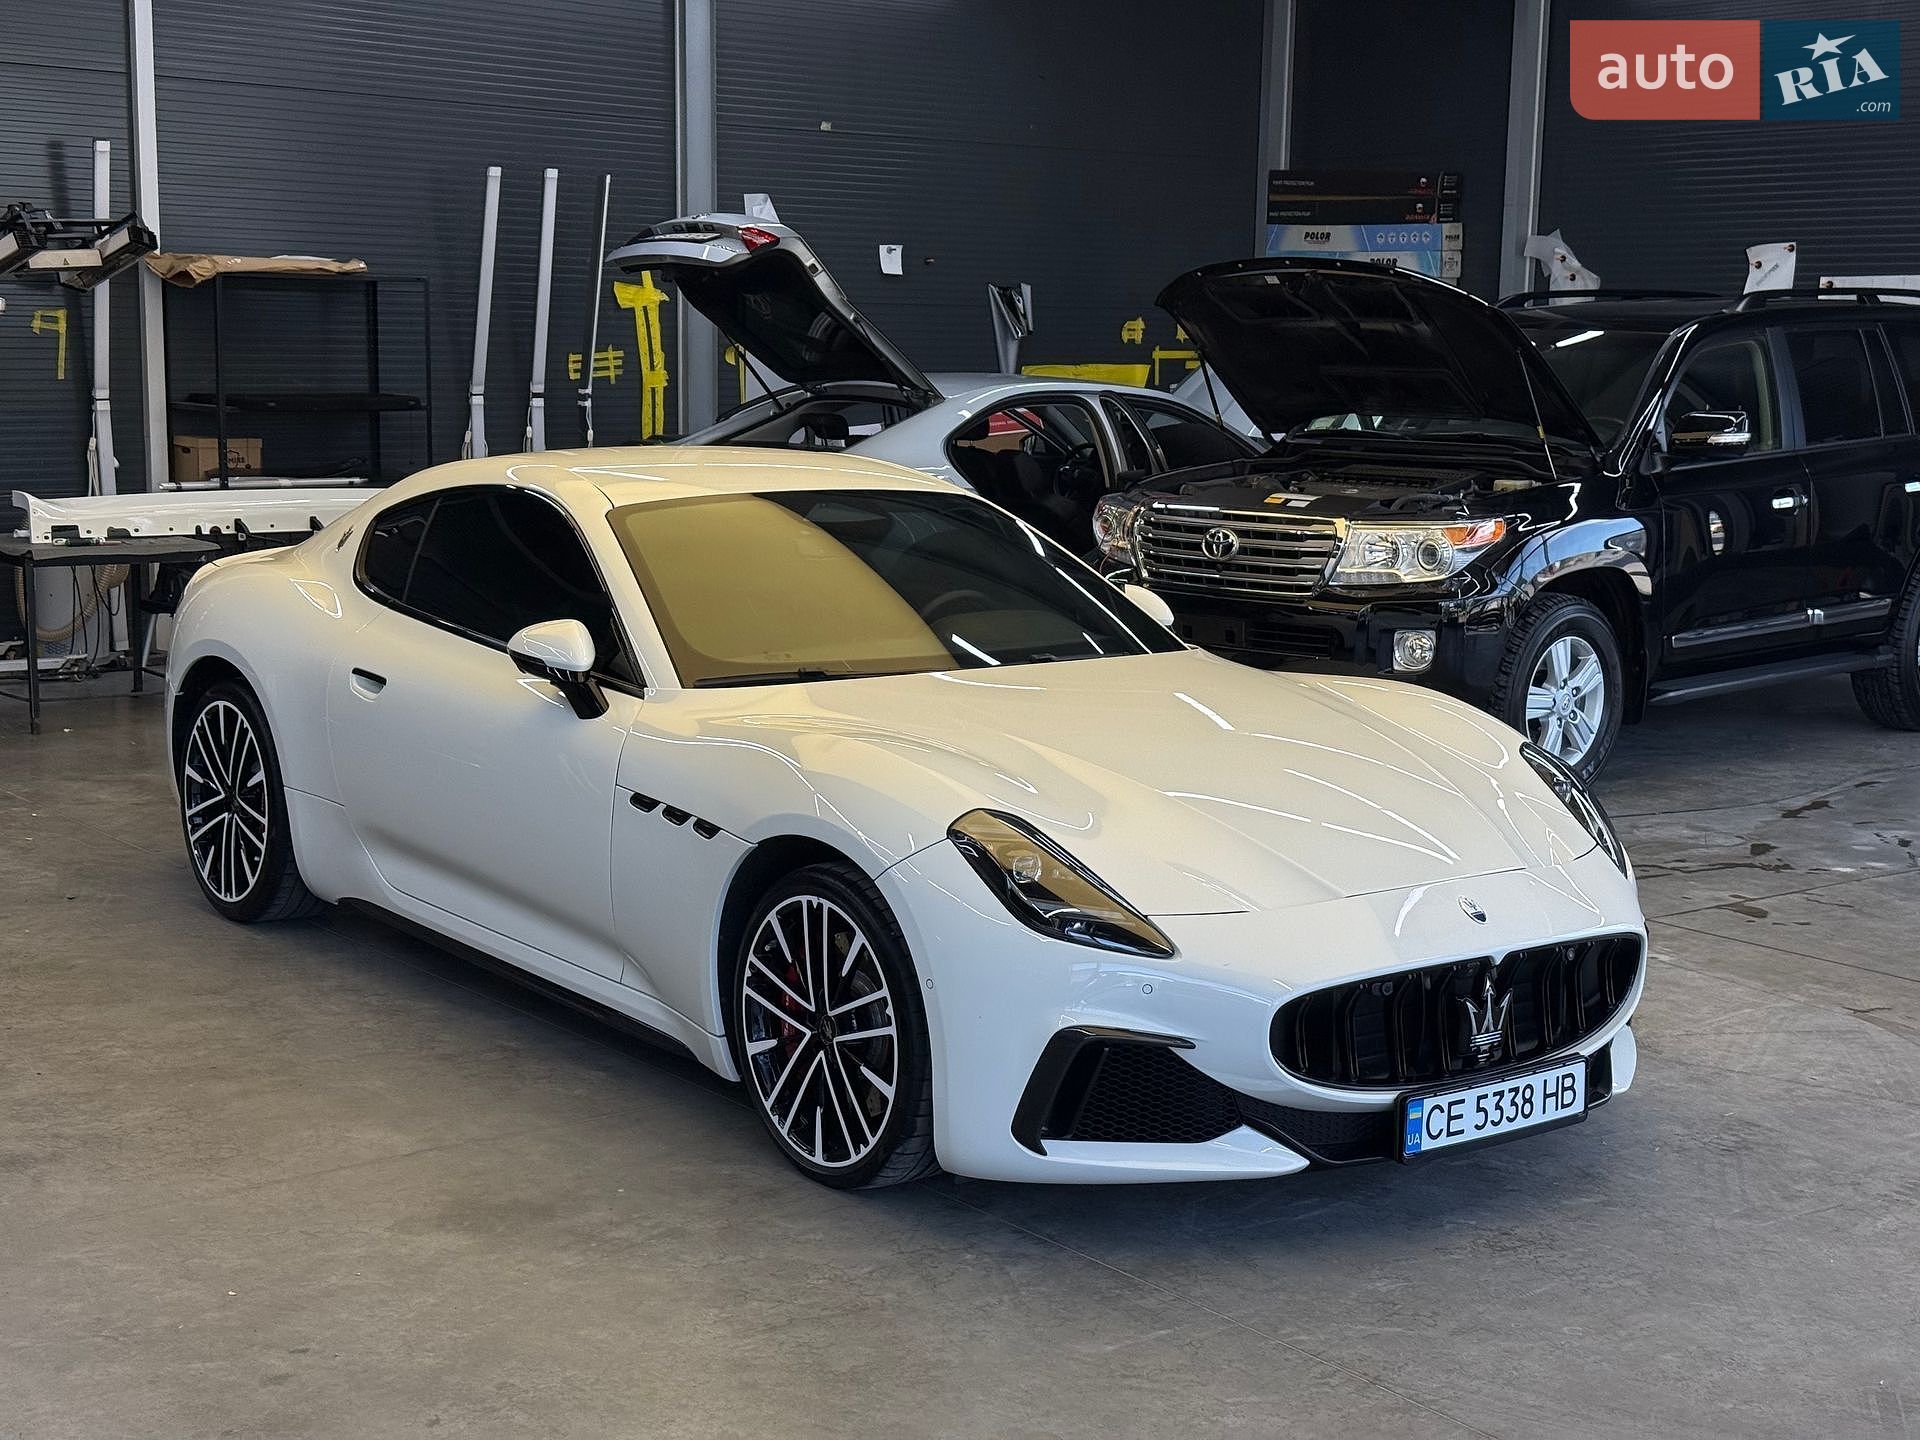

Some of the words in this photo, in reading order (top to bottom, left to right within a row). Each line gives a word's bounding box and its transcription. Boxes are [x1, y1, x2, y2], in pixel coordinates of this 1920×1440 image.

[1304, 231, 1331, 242] POLOR
[1425, 1098, 1466, 1141] CE
[1473, 1084, 1535, 1131] 5338
[1542, 1072, 1577, 1115] HB
[1407, 1133, 1421, 1146] UA
